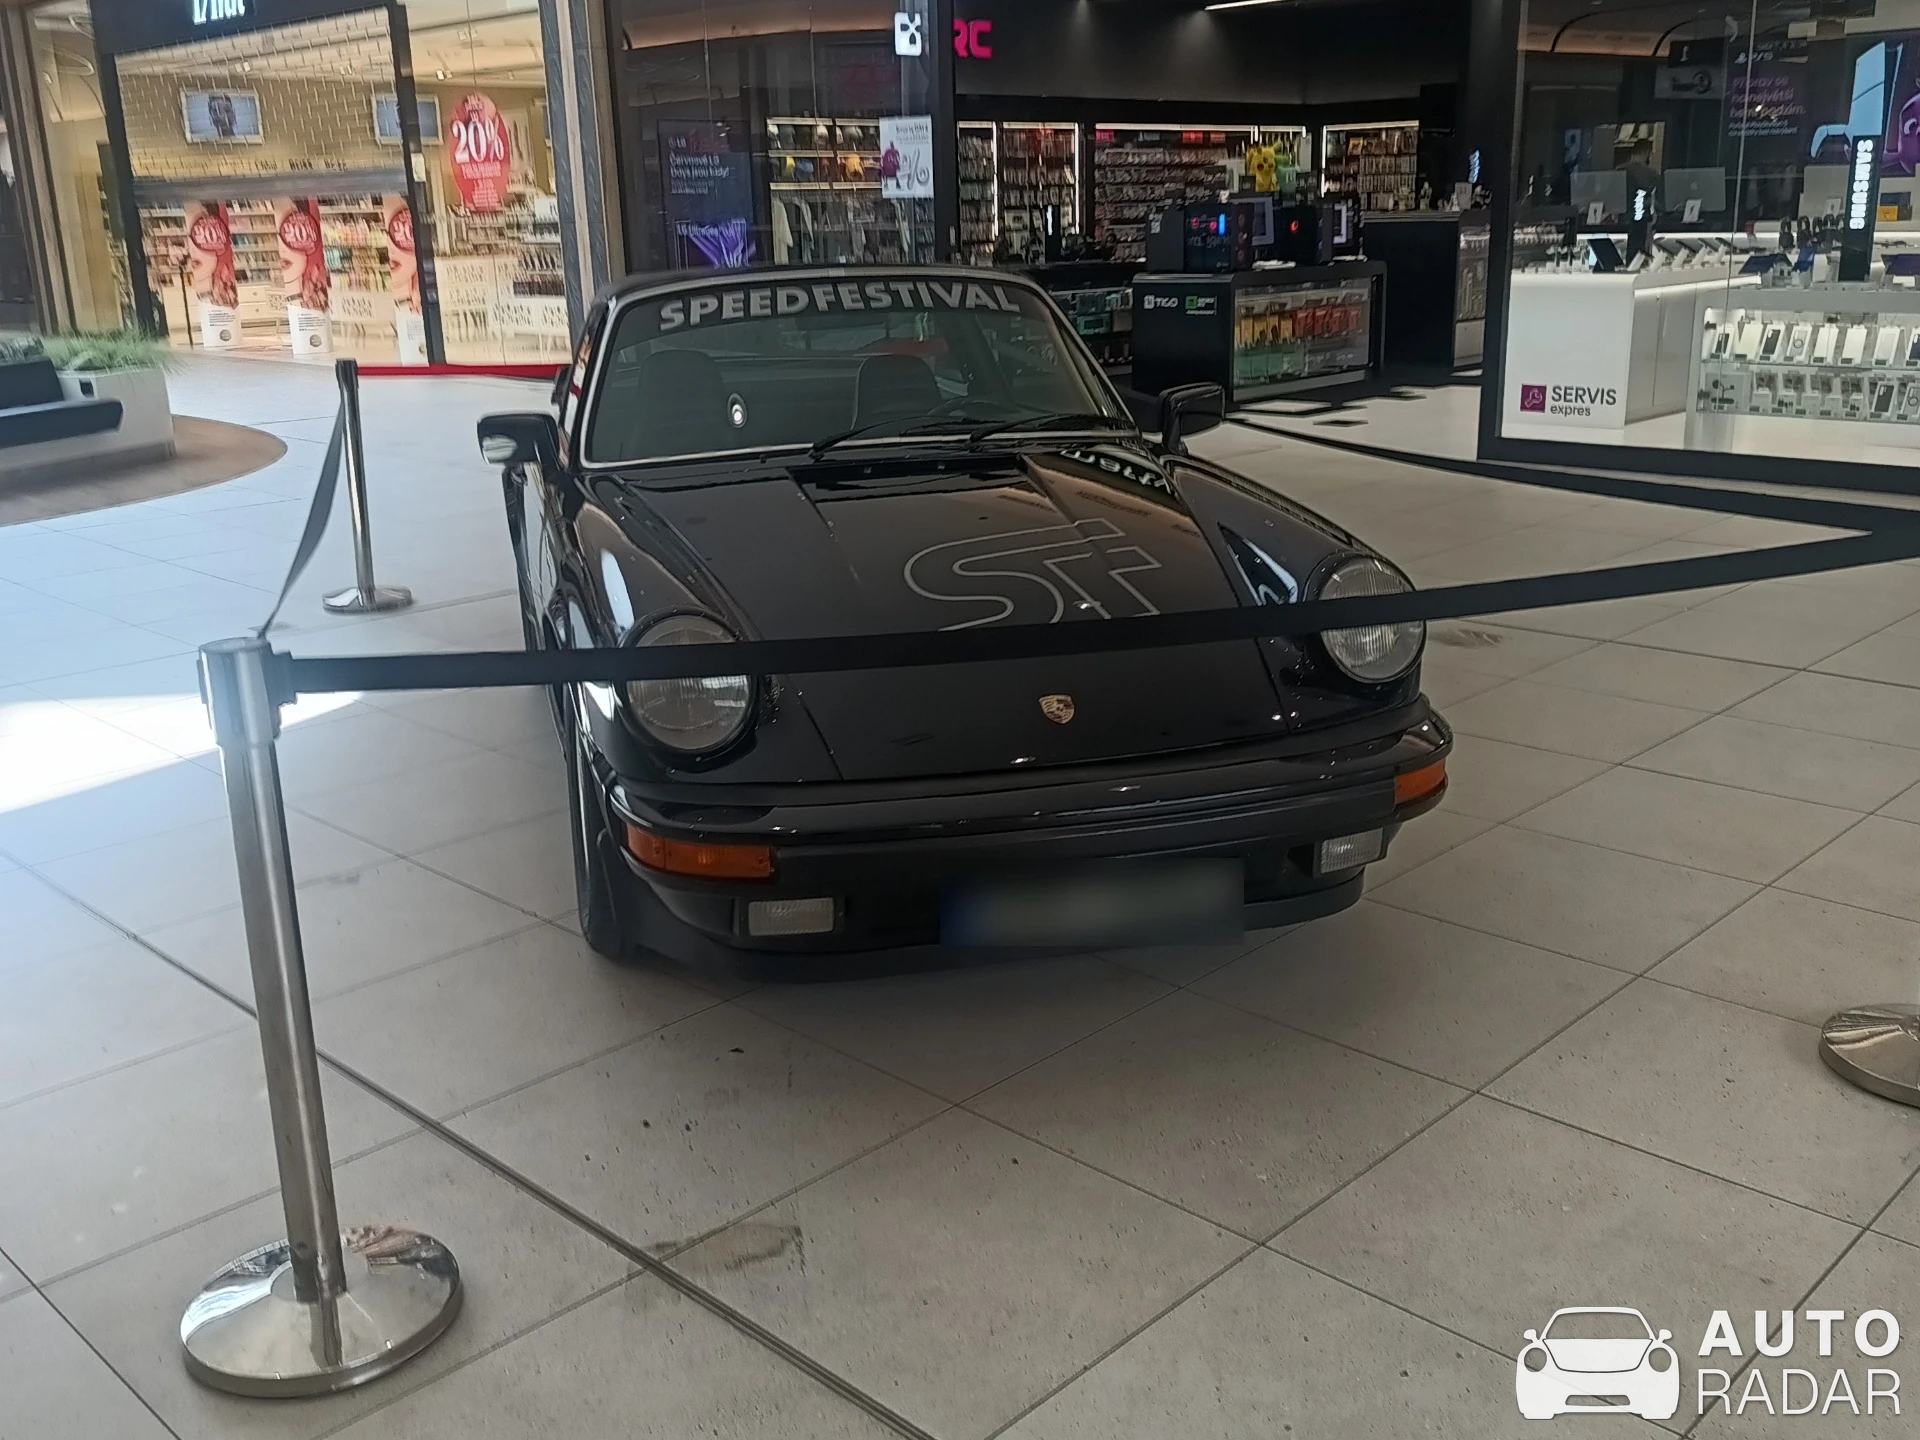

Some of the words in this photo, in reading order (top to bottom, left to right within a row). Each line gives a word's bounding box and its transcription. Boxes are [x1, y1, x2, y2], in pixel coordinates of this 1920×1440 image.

[452, 115, 505, 164] 20%
[1849, 139, 1874, 230] SAMSUNG
[193, 222, 227, 244] 20%
[283, 221, 317, 243] 20%
[660, 281, 1021, 331] SPEEDFESTIVAL
[1551, 385, 1617, 406] SERVIS
[1550, 404, 1591, 417] expres
